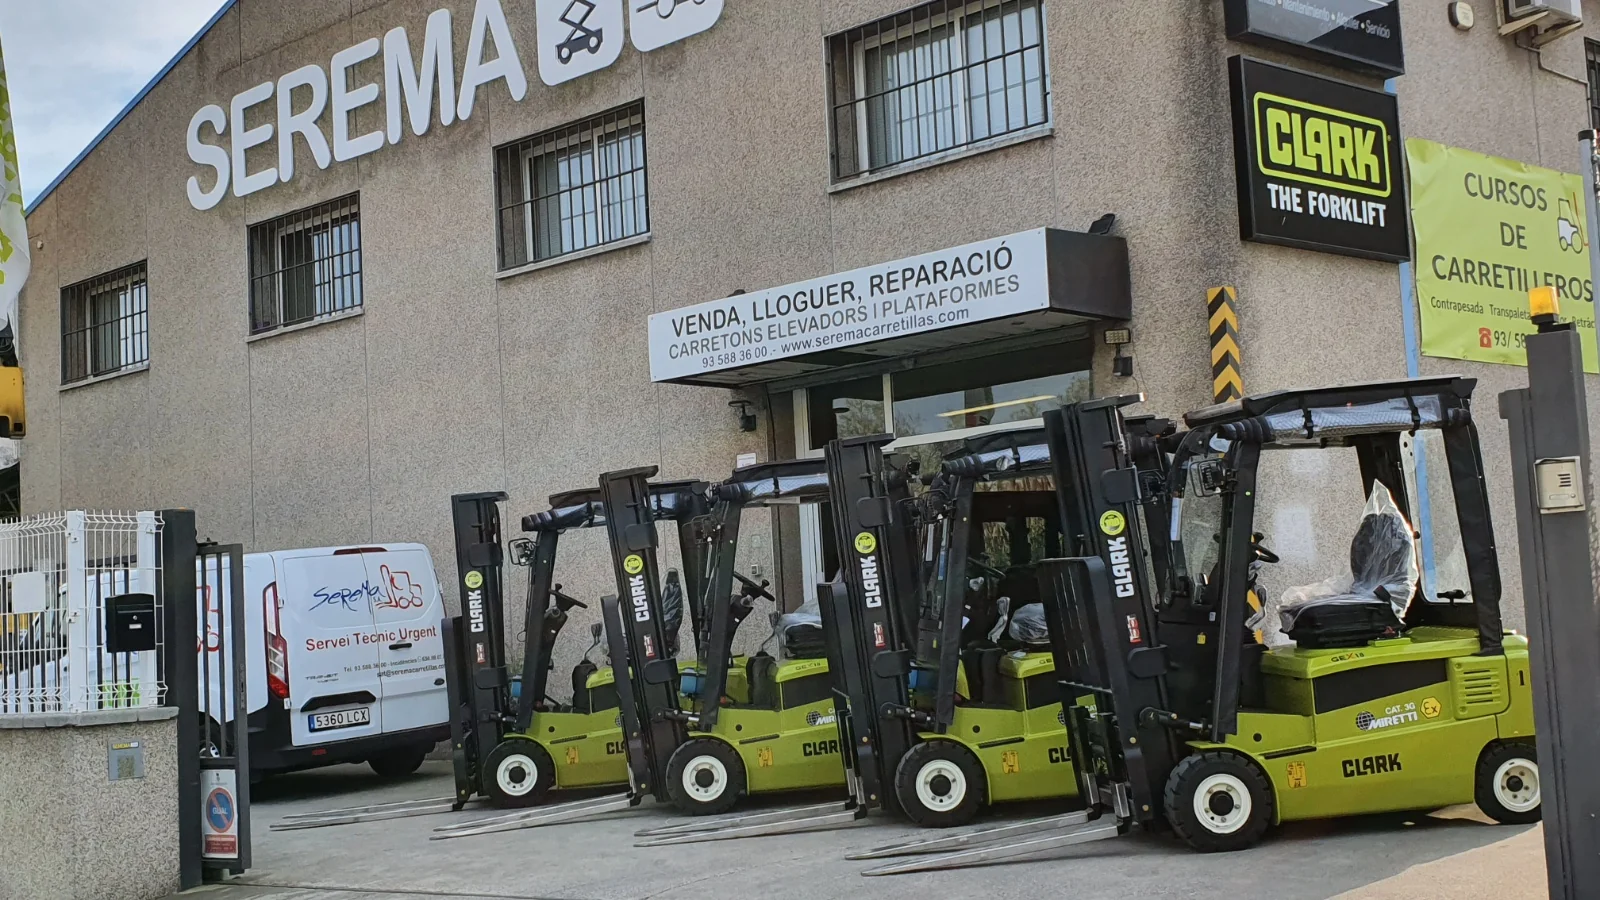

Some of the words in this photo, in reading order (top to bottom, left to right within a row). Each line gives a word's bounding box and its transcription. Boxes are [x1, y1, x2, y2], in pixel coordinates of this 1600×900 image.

[1366, 19, 1391, 39] Servicio
[186, 0, 528, 211] SEREMA
[1266, 107, 1380, 184] CLARK
[1266, 183, 1303, 214] THE
[1307, 190, 1386, 228] FORKLIFT
[1464, 172, 1548, 212] CURSOS
[1500, 221, 1527, 250] DE
[671, 305, 746, 338] VENDA,
[752, 280, 862, 322] LLOGUER,
[869, 240, 1013, 297] REPARACIÓ
[1430, 296, 1484, 314] Contrapesada
[668, 327, 763, 360] CARRETONS
[767, 304, 868, 341] ELEVADORS
[882, 274, 1020, 318] PLATAFORMES
[702, 355, 715, 368] 93
[717, 351, 737, 366] 588
[739, 347, 752, 362] 36
[754, 346, 768, 359] 00
[780, 308, 969, 354] www.seremacarretillas.com
[860, 555, 882, 608] CLARK
[1107, 536, 1135, 598] CLARK
[468, 590, 484, 633] CLARK
[629, 574, 650, 622] CLARK
[305, 634, 350, 652] Servei
[399, 625, 437, 642] Urgent
[316, 713, 344, 727] 5360
[347, 709, 367, 723] LCX
[1367, 711, 1418, 730] MIRETTI
[803, 739, 839, 757] CLAR
[1341, 753, 1402, 778] CLARK
